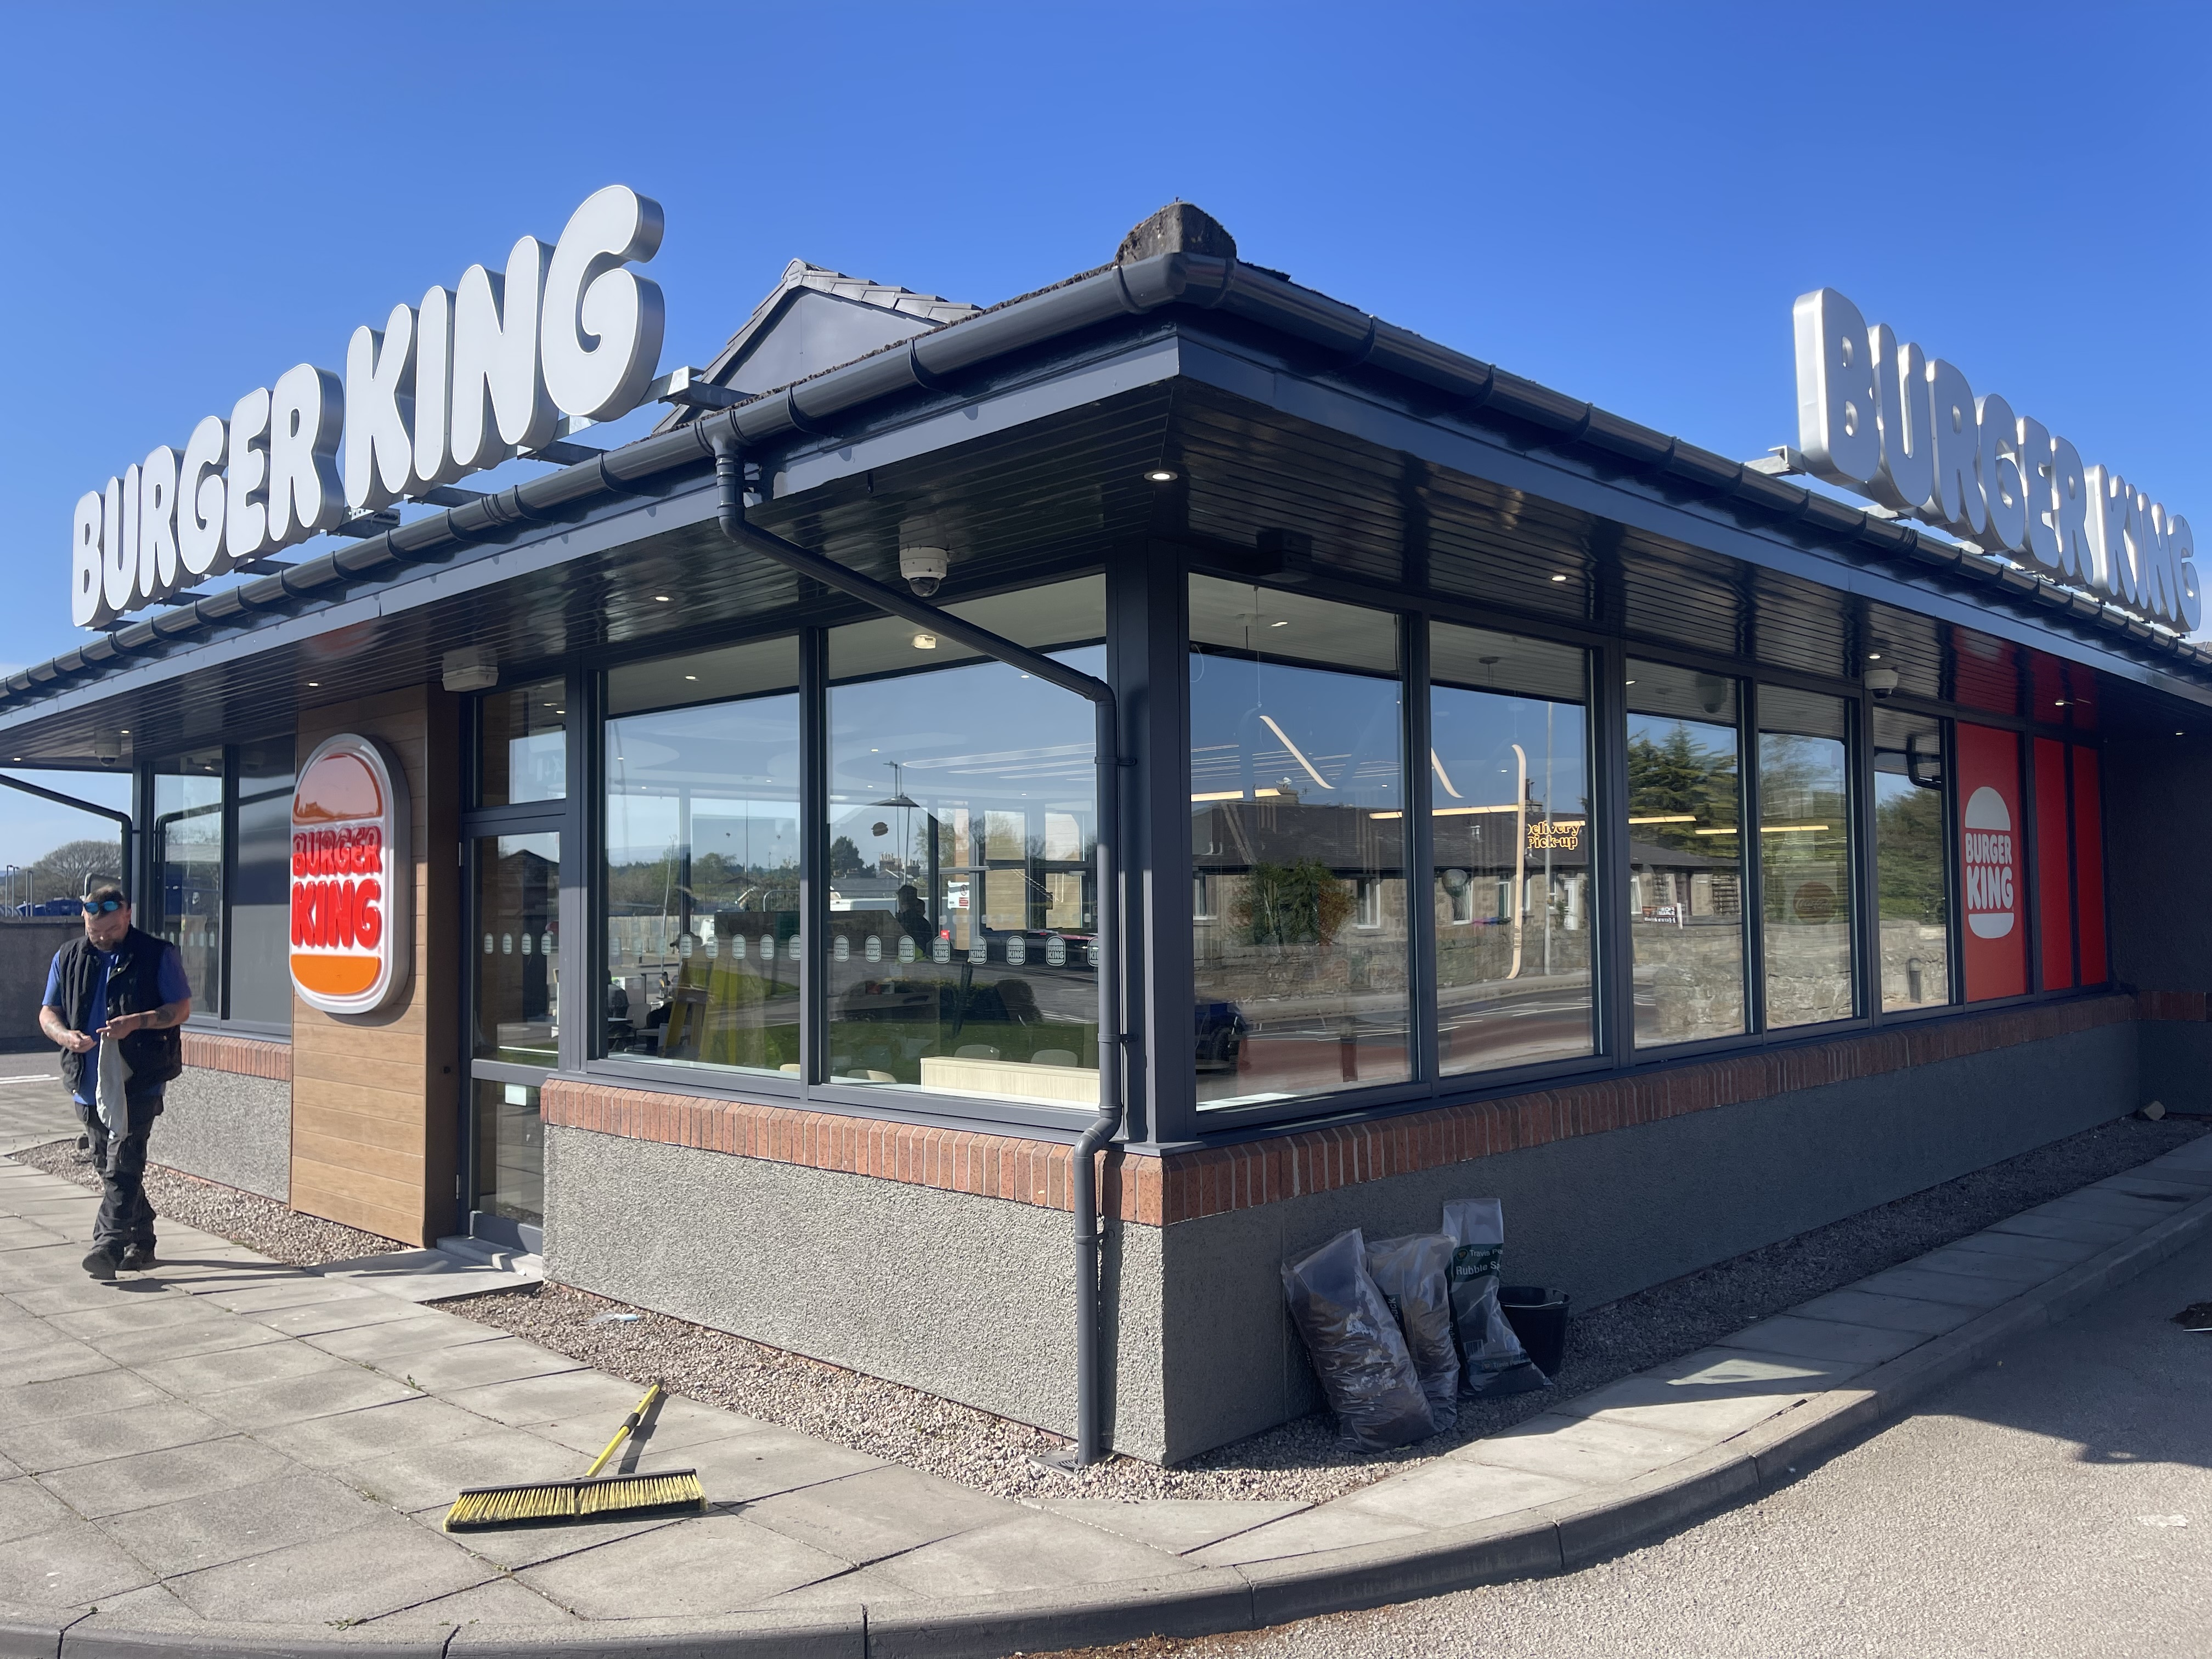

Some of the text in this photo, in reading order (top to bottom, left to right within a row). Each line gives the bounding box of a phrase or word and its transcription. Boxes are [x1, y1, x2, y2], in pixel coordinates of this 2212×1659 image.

[72, 184, 665, 628] BURGER KING
[1793, 287, 2202, 633] BURGER KING
[292, 826, 382, 877] BURGER
[1527, 834, 1578, 850] Pick-up
[1965, 832, 2012, 865] BURGER
[1966, 865, 2014, 910] KING
[291, 879, 382, 949] KING
[1048, 951, 1064, 959] KING
[1456, 1264, 1488, 1276] Rubble
